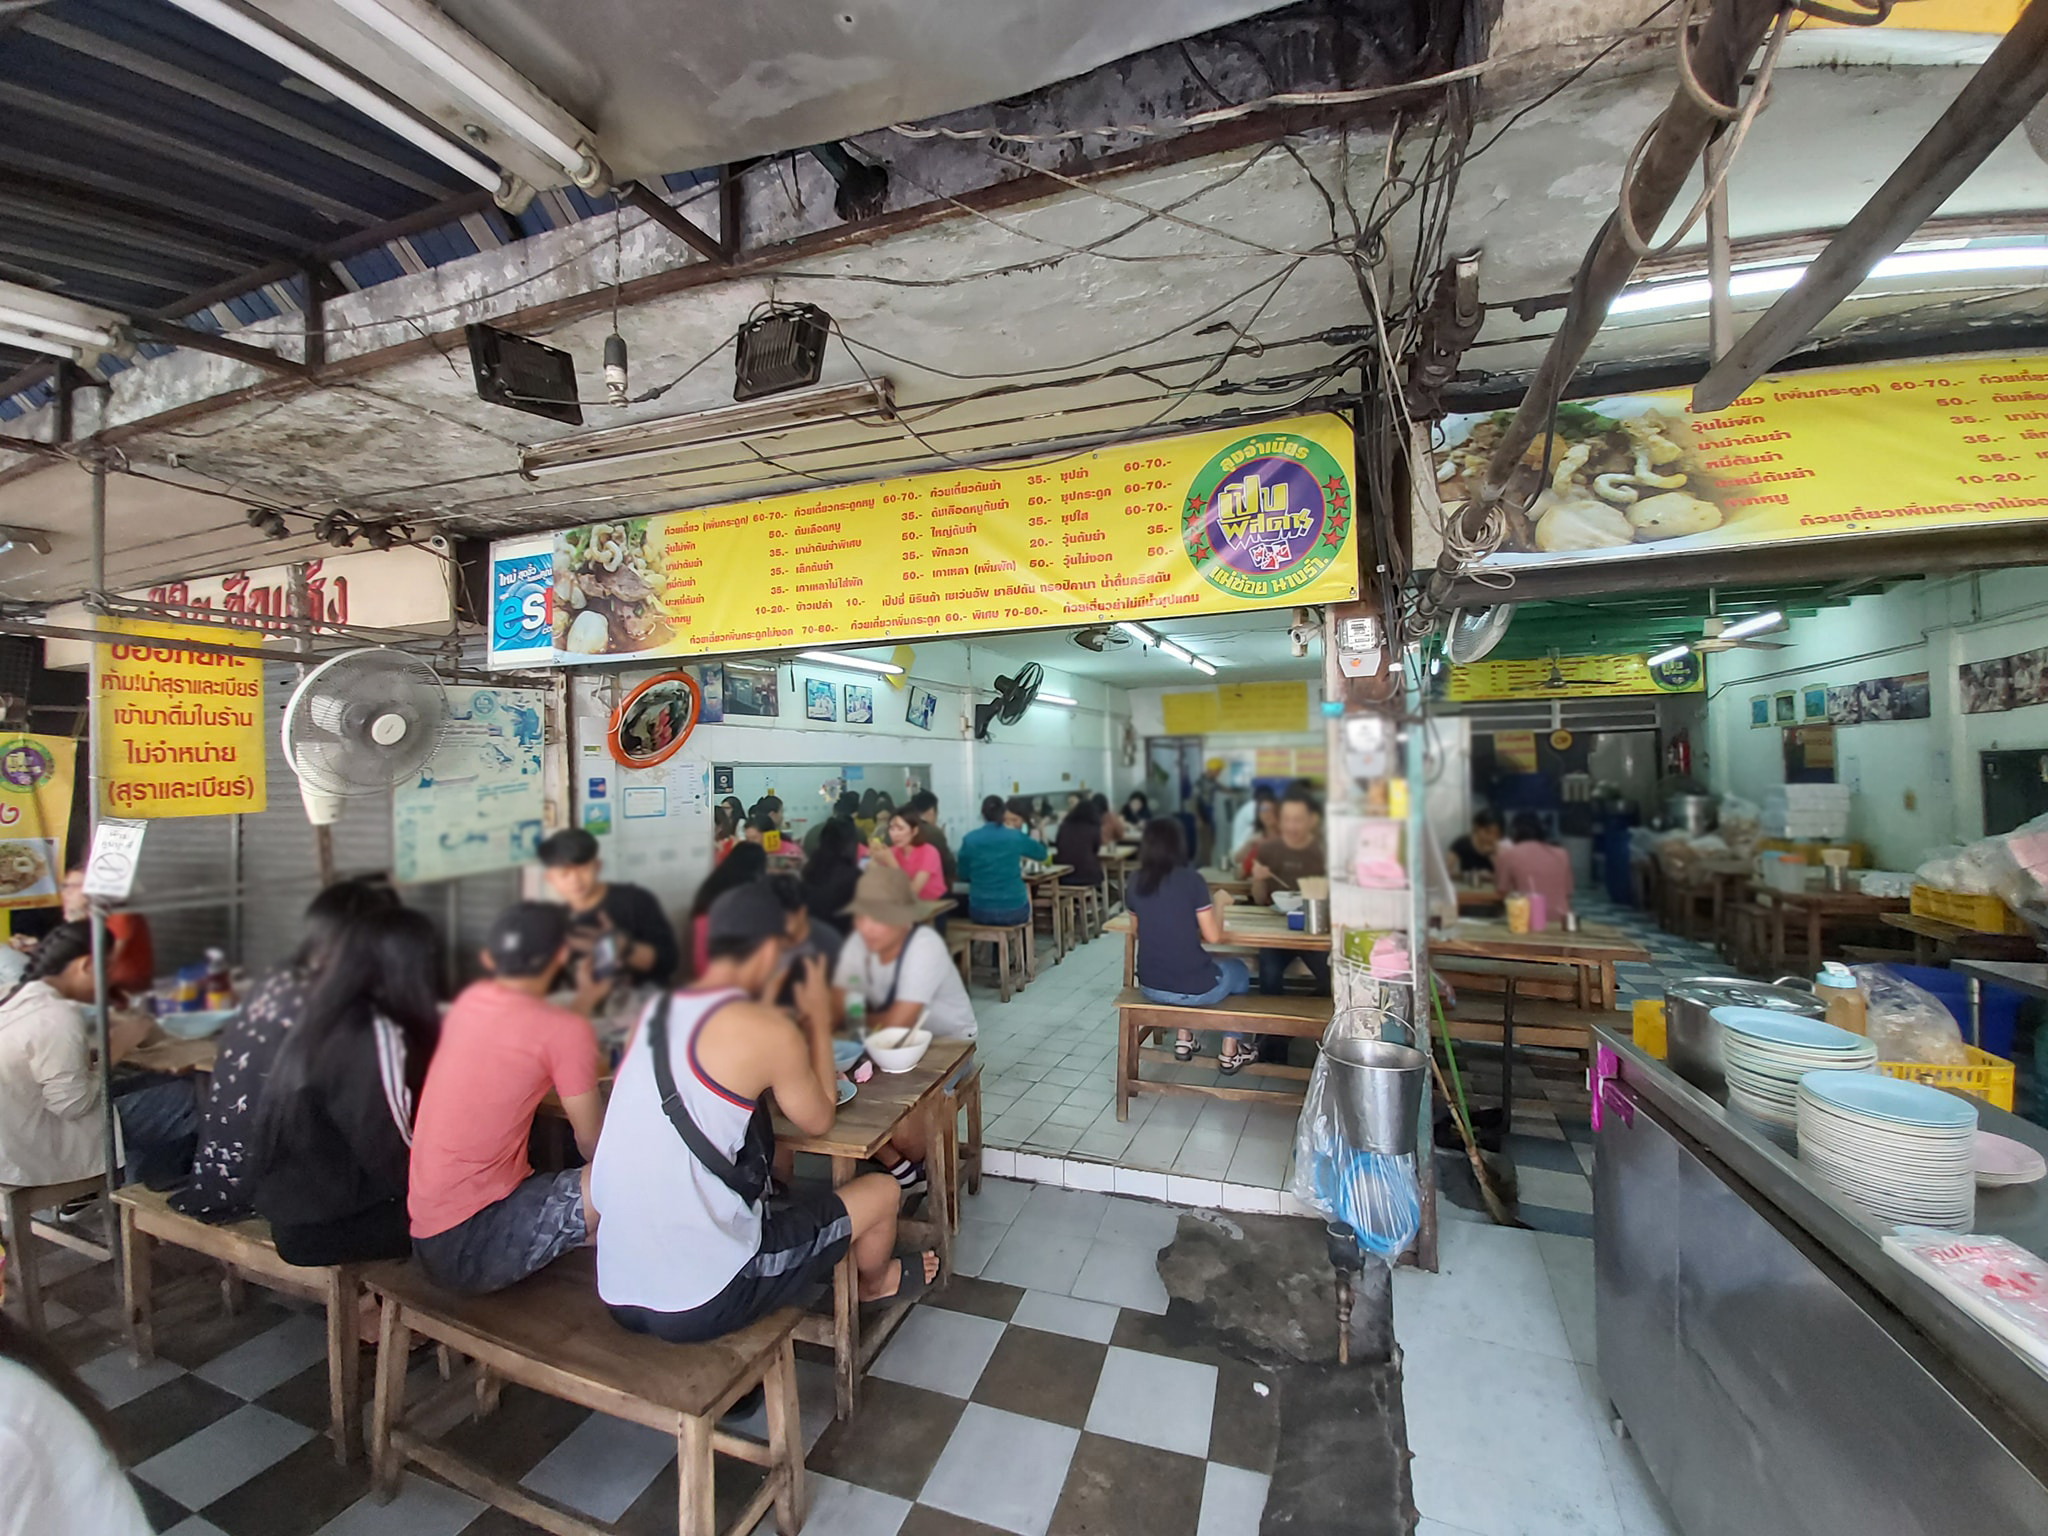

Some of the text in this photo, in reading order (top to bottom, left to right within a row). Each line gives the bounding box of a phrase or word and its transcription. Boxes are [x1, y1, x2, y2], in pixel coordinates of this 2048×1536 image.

[1888, 377, 1966, 391] 60-70.-
[1934, 397, 1979, 407] 50.-
[1949, 415, 1992, 425] 35.-
[1962, 433, 2007, 443] 35.-
[1978, 451, 2022, 463] 35.-
[752, 511, 789, 523] 60-70.-
[882, 491, 922, 505] 60-70.-
[1027, 473, 1051, 487] 35.-
[1123, 457, 1172, 473] 60-70.-
[1955, 471, 2038, 485] 10-20.-
[767, 529, 789, 539] 50.-
[901, 509, 923, 523] 35.-
[1028, 495, 1052, 507] 50.-
[1124, 479, 1173, 495] 60-70.-
[769, 547, 789, 557] 35.-
[900, 529, 924, 542] 50.-
[1029, 515, 1053, 527] 35.-
[1124, 501, 1173, 517] 60-70.-
[769, 565, 789, 577] 35.-
[902, 549, 924, 561] 35.-
[1030, 537, 1054, 549] 20.-
[1147, 522, 1175, 535] 35.-
[769, 585, 791, 596] 35.-
[902, 569, 925, 583] 50.-
[1029, 558, 1055, 569] 50.-
[1147, 545, 1174, 557] 50.-
[754, 605, 790, 615] 10-20.-
[845, 597, 866, 608] 10.-
[801, 623, 839, 635] 70-80.-
[944, 613, 967, 623] 60.-
[1004, 607, 1048, 619] 70-80.-
[112, 698, 255, 730] เข้ามาดื่มในร้าน
[120, 736, 239, 767] ไม่จำหน่าย
[107, 771, 257, 809] (สุราและเบียร์)
